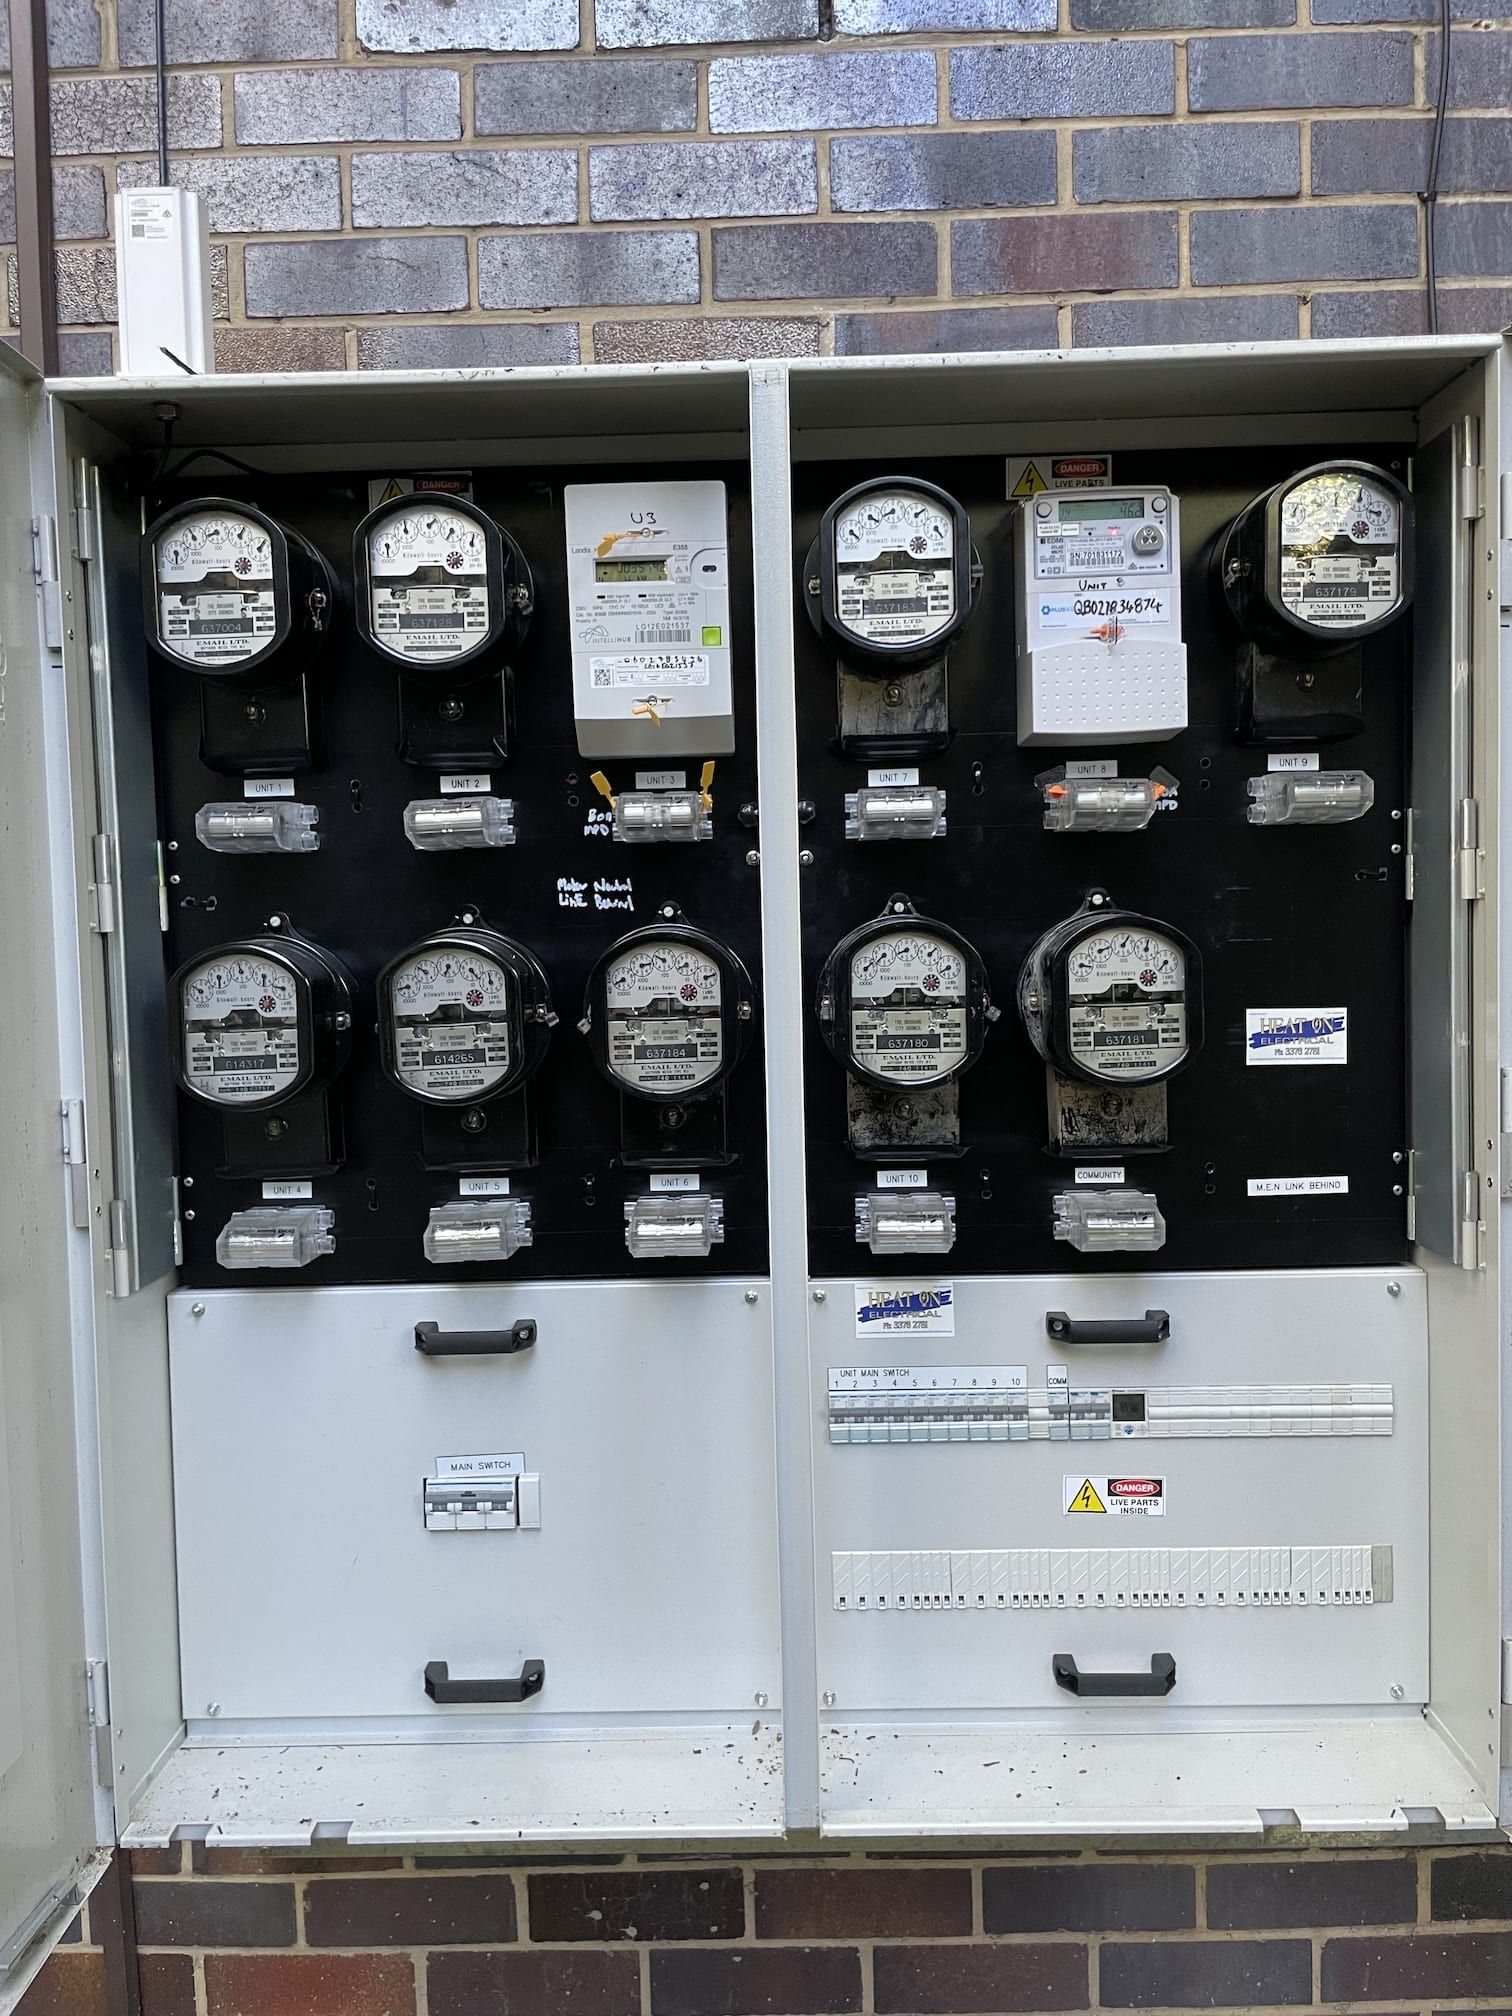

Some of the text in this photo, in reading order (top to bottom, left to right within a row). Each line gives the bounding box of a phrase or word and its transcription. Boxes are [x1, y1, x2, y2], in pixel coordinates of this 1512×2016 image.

[1061, 464, 1099, 473] DANGER
[422, 481, 460, 489] DANGER
[1056, 480, 1073, 488] LIVE
[1079, 580, 1107, 591] UNIT
[1316, 588, 1357, 596] 637179
[202, 624, 241, 633] 637004
[1280, 758, 1308, 767] UNIT 9
[1078, 765, 1106, 774] UNIT 8
[647, 776, 675, 785] UNIT 3
[880, 773, 908, 783] UNIT 7
[256, 784, 282, 792] UNIT 1
[452, 780, 480, 788] UNIT 2
[1260, 1017, 1334, 1034] HEAT ON
[888, 1039, 929, 1048] 637180
[1106, 1036, 1145, 1045] 637181
[1261, 1037, 1334, 1045] ELECTRICAL
[647, 1049, 686, 1058] 637184
[435, 1054, 474, 1063] 614265
[226, 1060, 265, 1069] 614317
[887, 1175, 919, 1184] UNIT 10
[1078, 1171, 1122, 1179] COMMUNITY
[469, 1182, 500, 1191] UNIT 5
[661, 1178, 689, 1187] UNIT 6
[1310, 1182, 1341, 1190] BEHIND
[274, 1186, 292, 1195] UNIT
[868, 1291, 941, 1308] HEAT ON
[869, 1311, 942, 1319] ELECTRICAL
[861, 1369, 879, 1377] MAIN
[884, 1369, 909, 1377] SWITCH
[853, 1380, 858, 1388] 2
[913, 1379, 918, 1387] 5
[933, 1379, 937, 1387] 6
[1012, 1378, 1021, 1386] 10
[479, 1461, 511, 1470] SWITCH
[1116, 1484, 1154, 1492] DANGER
